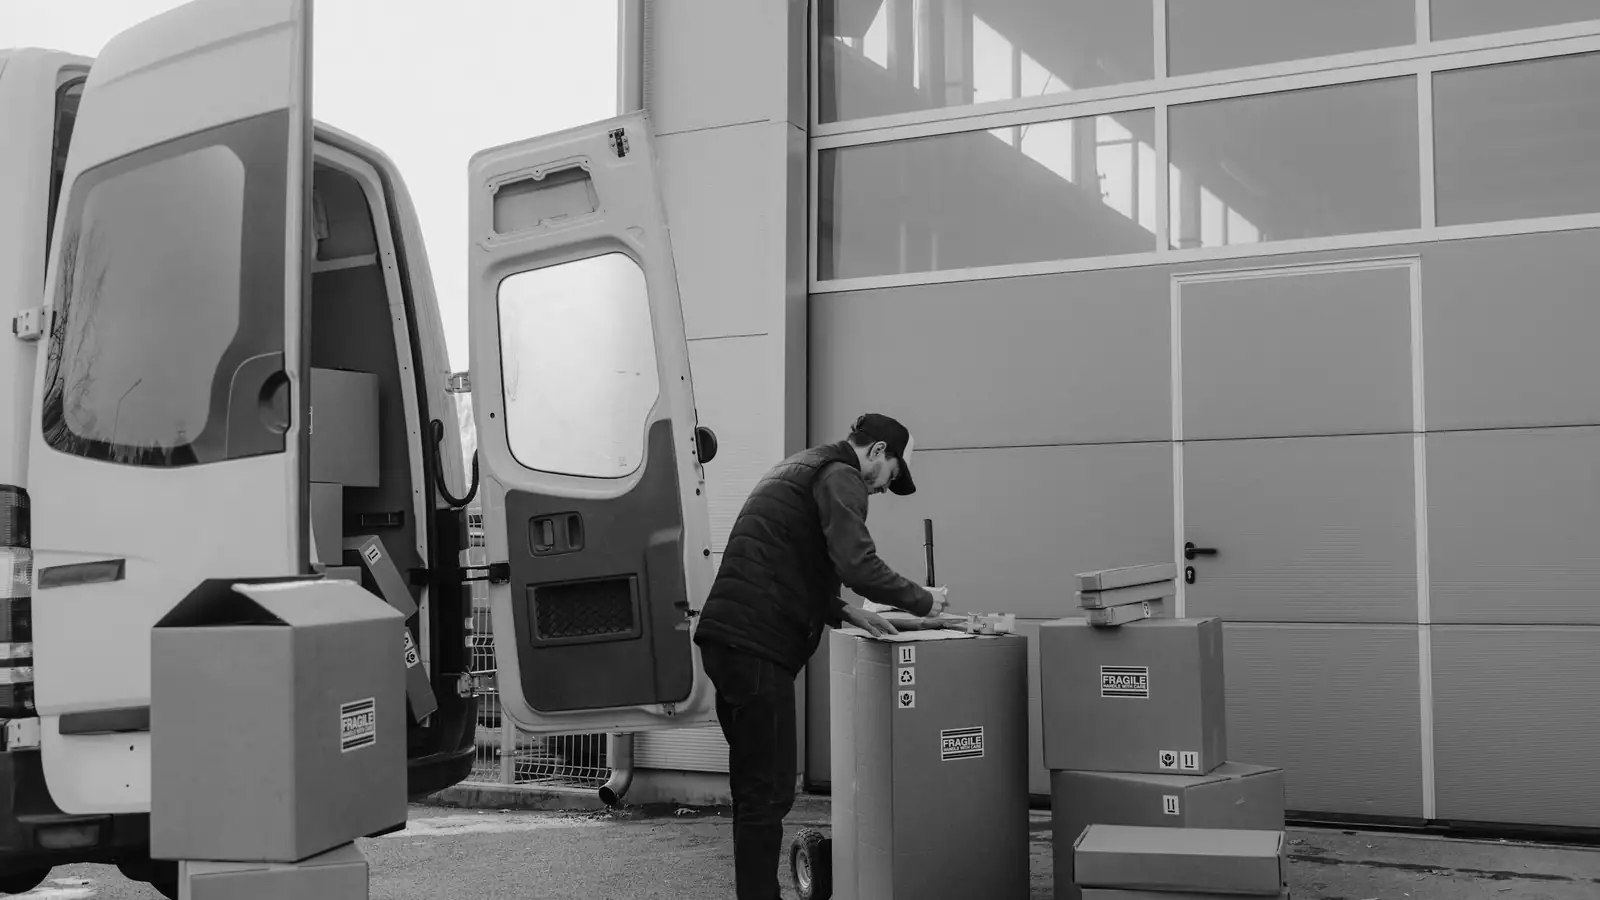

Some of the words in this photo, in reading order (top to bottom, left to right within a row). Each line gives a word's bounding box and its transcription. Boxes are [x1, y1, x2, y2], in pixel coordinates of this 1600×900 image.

[1103, 675, 1146, 685] FRAGILE
[343, 712, 374, 732] FRAGILE
[943, 736, 981, 748] FRAGILE
